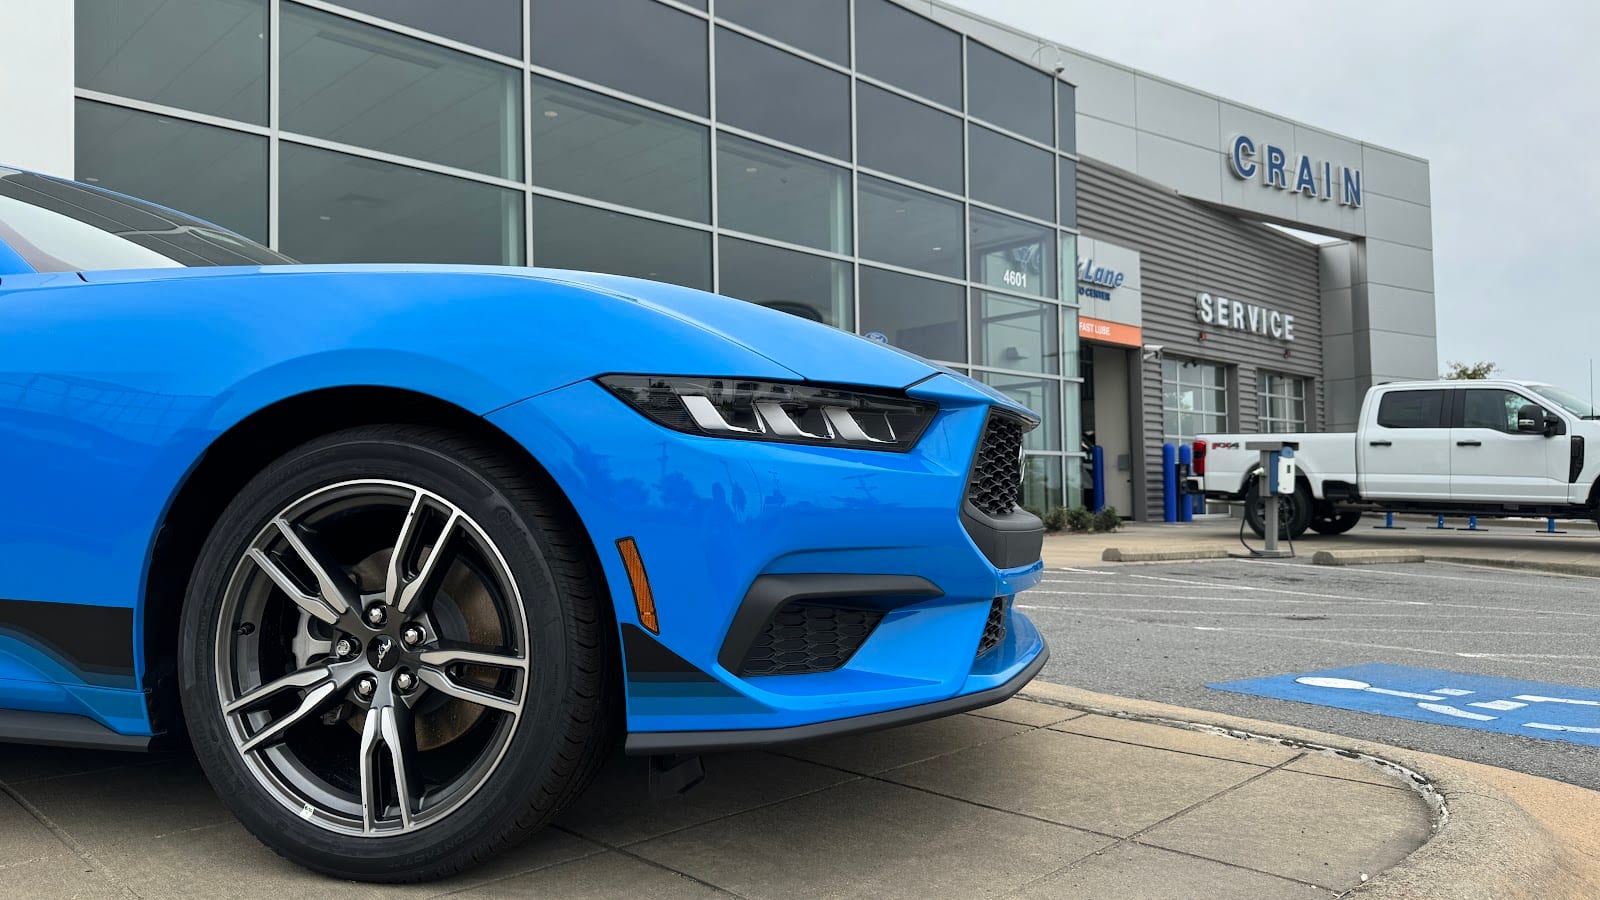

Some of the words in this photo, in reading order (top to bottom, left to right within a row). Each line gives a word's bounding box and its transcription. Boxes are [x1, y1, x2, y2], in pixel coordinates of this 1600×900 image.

[1230, 134, 1362, 208] CRAIN
[1003, 269, 1027, 288] 4601
[1084, 259, 1124, 287] Lane
[1085, 288, 1111, 301] CENTER
[1198, 292, 1294, 340] SERVICE
[1079, 321, 1095, 333] FAST
[1095, 325, 1111, 336] LUBE
